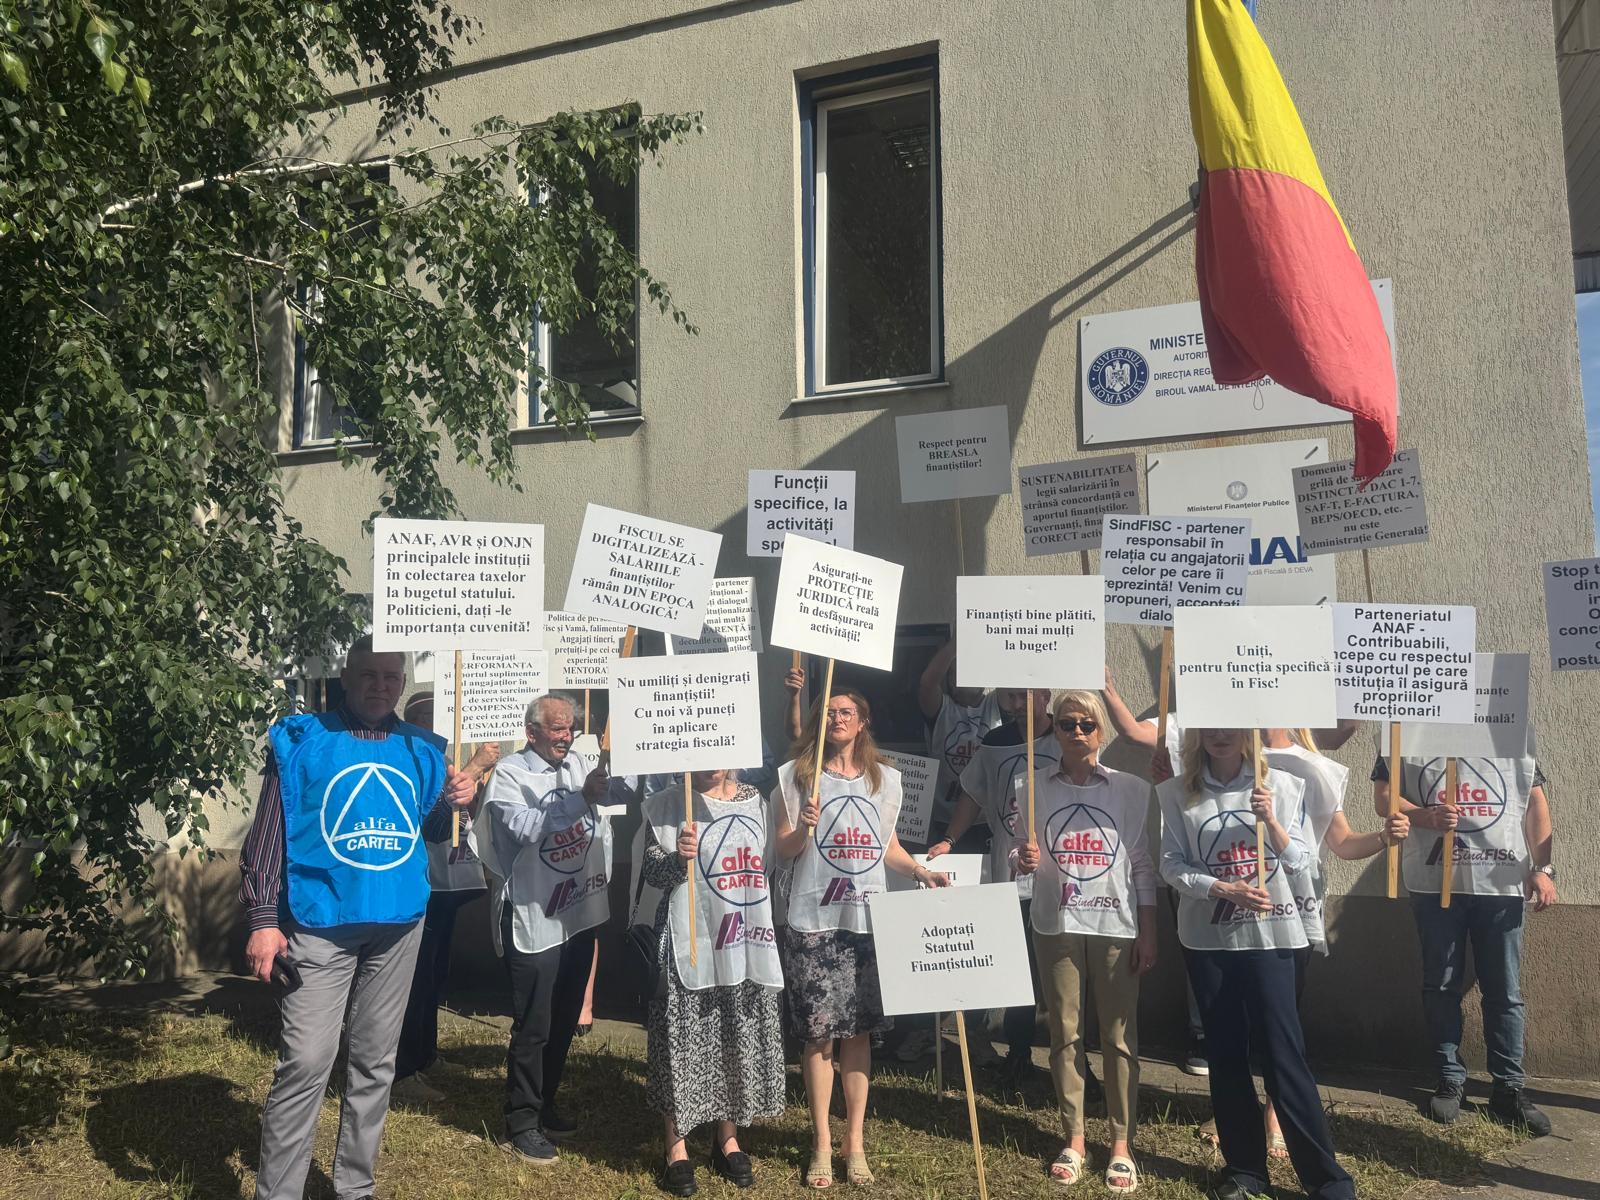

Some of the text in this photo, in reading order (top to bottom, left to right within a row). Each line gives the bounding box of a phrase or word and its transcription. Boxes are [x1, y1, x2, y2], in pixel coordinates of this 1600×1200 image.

[1150, 333, 1204, 350] MINISTE
[1092, 350, 1143, 372] GUVERNUL
[1154, 370, 1192, 380] DIRECȚIA
[1156, 387, 1186, 397] BIROUL
[1188, 384, 1216, 394] VAMAL
[919, 437, 987, 449] Respect pentru
[929, 448, 978, 460] BREASLA
[1022, 464, 1133, 487] SUSTENABILITATEA
[1301, 464, 1346, 478] Domeniu
[775, 475, 828, 493] Funcții
[1337, 476, 1348, 485] de
[1370, 480, 1396, 492] DAC
[1037, 487, 1056, 497] legii
[754, 497, 847, 512] specifice, la
[1033, 510, 1068, 522] aportul
[767, 518, 833, 535] activități
[1109, 519, 1245, 535] SindFISC partener
[1360, 522, 1380, 530] este
[387, 532, 533, 550] ANAF, AVR și ONJN
[619, 524, 685, 548] FISCUL SE
[1031, 532, 1078, 544] CORECT
[1126, 536, 1224, 549] responsabil în
[592, 533, 696, 566] DIGITALIZEAZĂ
[387, 551, 530, 568] principalele instituții
[609, 552, 681, 576] SALARIILE
[1105, 549, 1244, 566] relația cu angajatorii
[386, 568, 526, 582] în colectarea taxelor
[813, 561, 873, 585] Asigurați-ne
[1122, 565, 1224, 579] celor pe care îi
[1552, 566, 1588, 578] Stop
[716, 580, 749, 588] partener
[808, 574, 874, 600] PROTECȚIE
[1178, 581, 1242, 596] Venim cu
[1574, 579, 1598, 591] din
[387, 587, 515, 600] la bugetul statului.
[582, 578, 620, 592] rămân
[623, 585, 647, 597] DIN
[650, 591, 695, 609] EPOCA
[592, 594, 678, 620] ANALOGICĂ!
[717, 597, 748, 605] dialogul
[797, 587, 879, 617] JURIDICĂ reală
[387, 604, 460, 617] Politicieni,
[800, 603, 873, 630] în desfășurarea
[966, 609, 1051, 622] Finanțiști bine
[1354, 608, 1451, 621] Parteneriatul
[548, 614, 575, 622] Politica
[386, 622, 530, 636] importanța cuvenită!
[811, 623, 860, 642] activității!
[986, 625, 1074, 637] bani mai mulți
[1372, 623, 1415, 634] ANAF
[1005, 640, 1057, 653] la buget!
[1347, 635, 1449, 650] Contribuabili,
[1236, 646, 1272, 658] Uniți,
[1379, 653, 1471, 664] cu respectul
[1179, 663, 1222, 674] pentru
[1227, 662, 1272, 674] funcția
[1276, 662, 1330, 674] specifică
[1346, 665, 1408, 677] suportul
[1414, 667, 1430, 678] pe
[1436, 668, 1467, 676] care
[617, 672, 750, 688] Nu umiliți și denigrați
[1231, 678, 1278, 688] în Fisc!
[1399, 678, 1468, 692] îl asigură
[653, 689, 715, 702] finanțiștii!
[1363, 692, 1434, 704] propriilor
[634, 704, 735, 718] Cu noi vă puneți
[1354, 703, 1441, 718] funcționari!
[463, 714, 474, 722] pe
[653, 722, 718, 735] în aplicare
[636, 736, 735, 751] strategia fiscală!
[354, 817, 397, 830] alfa
[834, 827, 871, 845] alfa
[1063, 833, 1103, 851] alfa
[347, 836, 401, 851] CARTEL
[722, 848, 763, 871] alfa
[828, 849, 877, 860] CARTEL
[1058, 855, 1109, 866] CARTEL
[1067, 896, 1120, 908] SindFISC
[921, 923, 974, 938] Adoptați
[925, 940, 974, 954] Statutul
[911, 955, 994, 973] Finanțistului!
